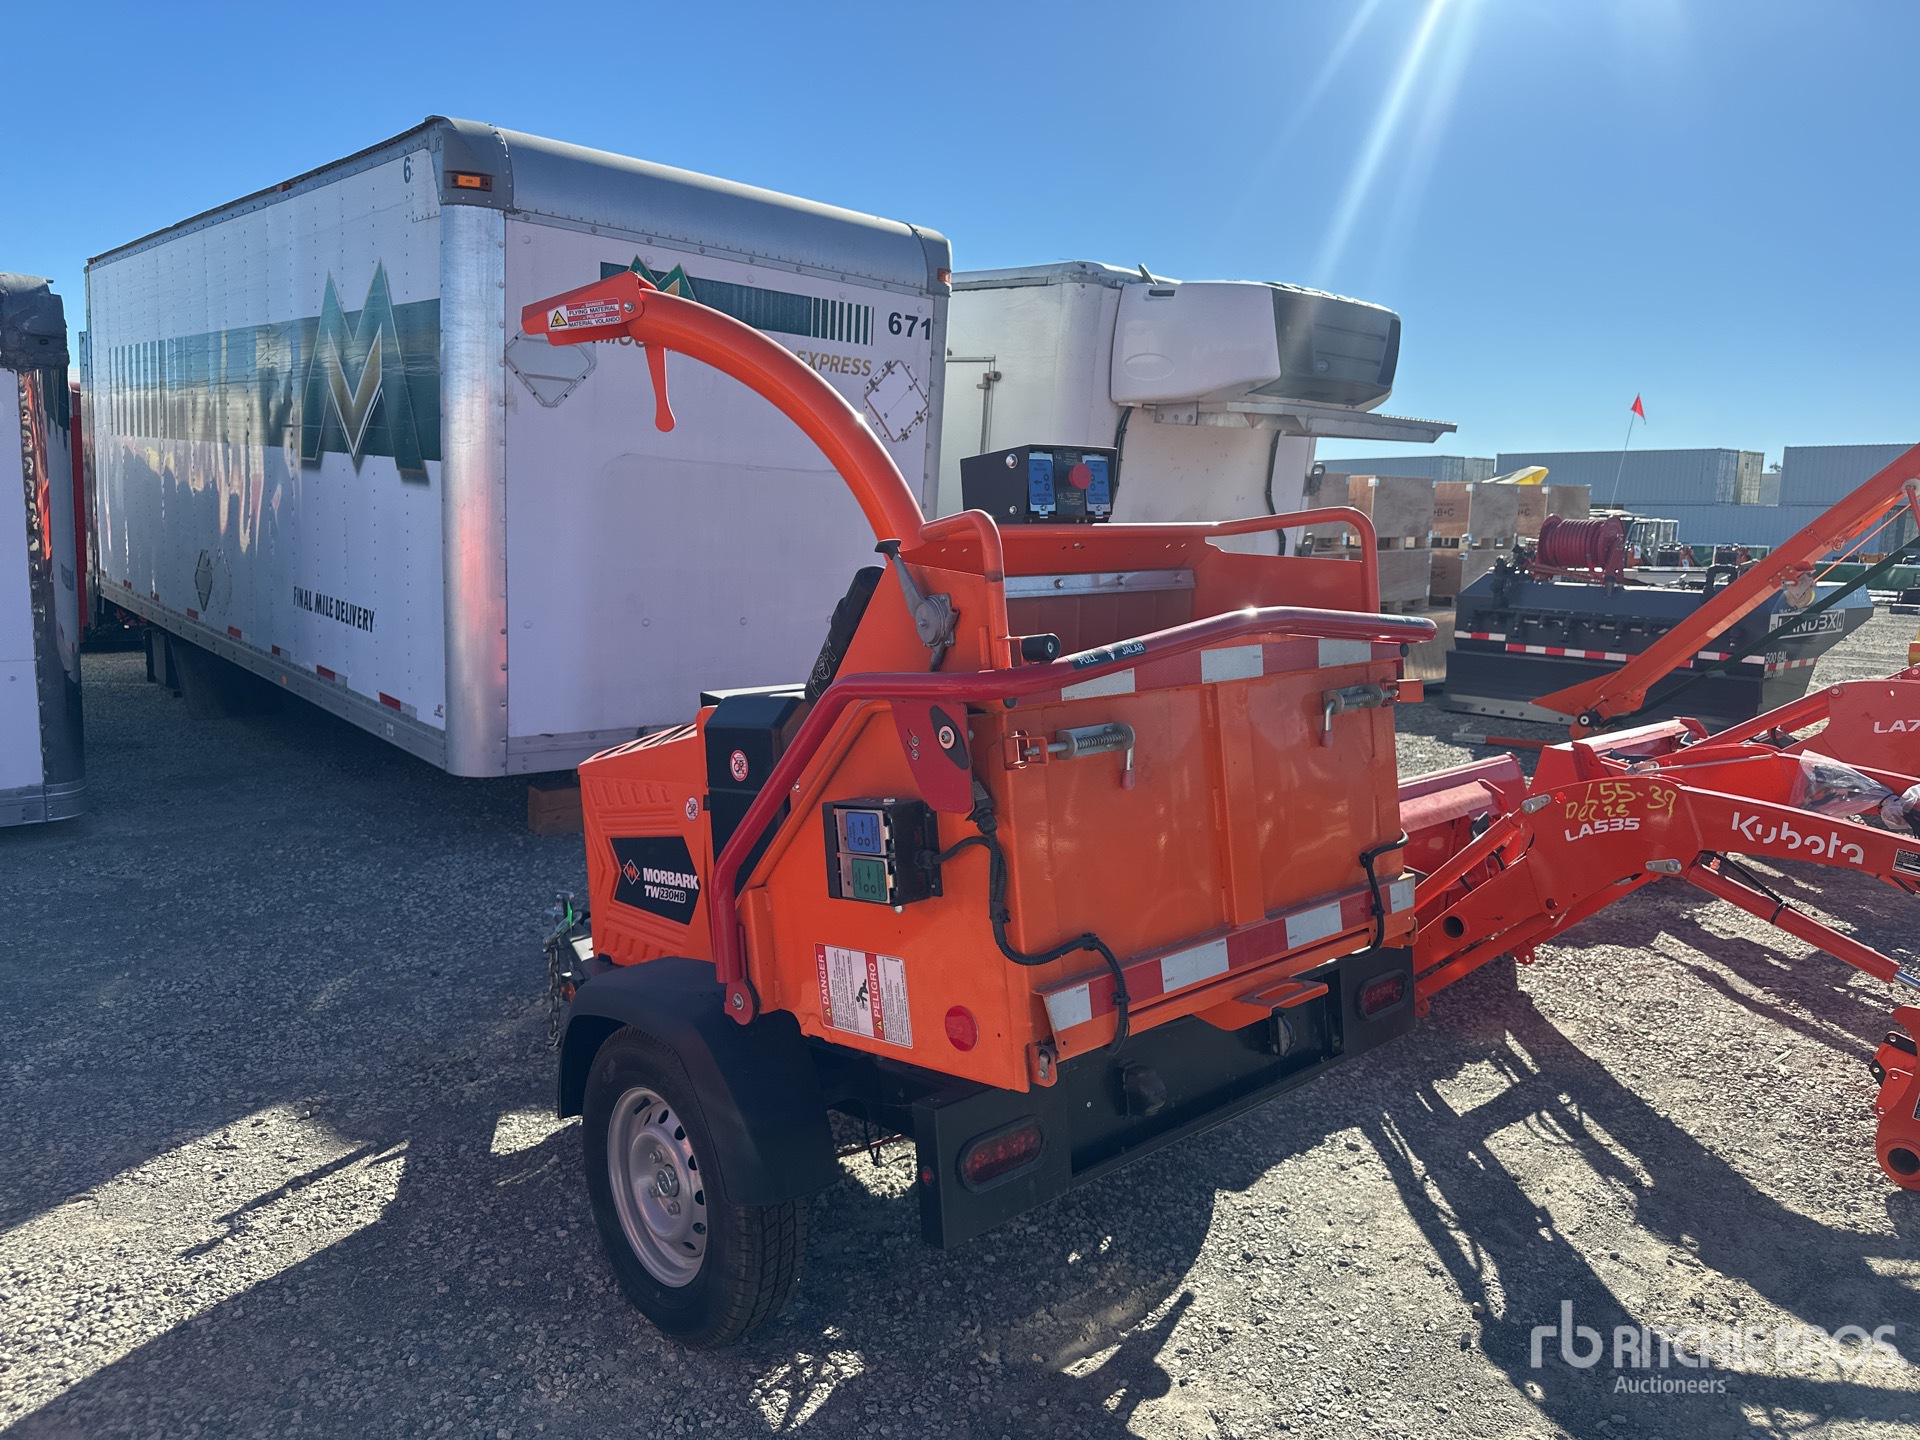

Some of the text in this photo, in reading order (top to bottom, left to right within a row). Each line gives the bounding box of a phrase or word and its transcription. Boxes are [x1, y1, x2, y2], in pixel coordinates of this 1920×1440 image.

[403, 155, 412, 184] 6
[569, 320, 594, 328] MATERIAL
[888, 311, 931, 341] 671
[293, 585, 375, 633] FINAL MILE DELIVERY
[1077, 643, 1145, 665] PULL JALAR
[1564, 817, 1641, 842] LA535
[1731, 811, 1865, 865] Kubota
[642, 867, 700, 890] MORBARK
[817, 954, 830, 1005] DANGER
[868, 962, 881, 1018] PELIGRO
